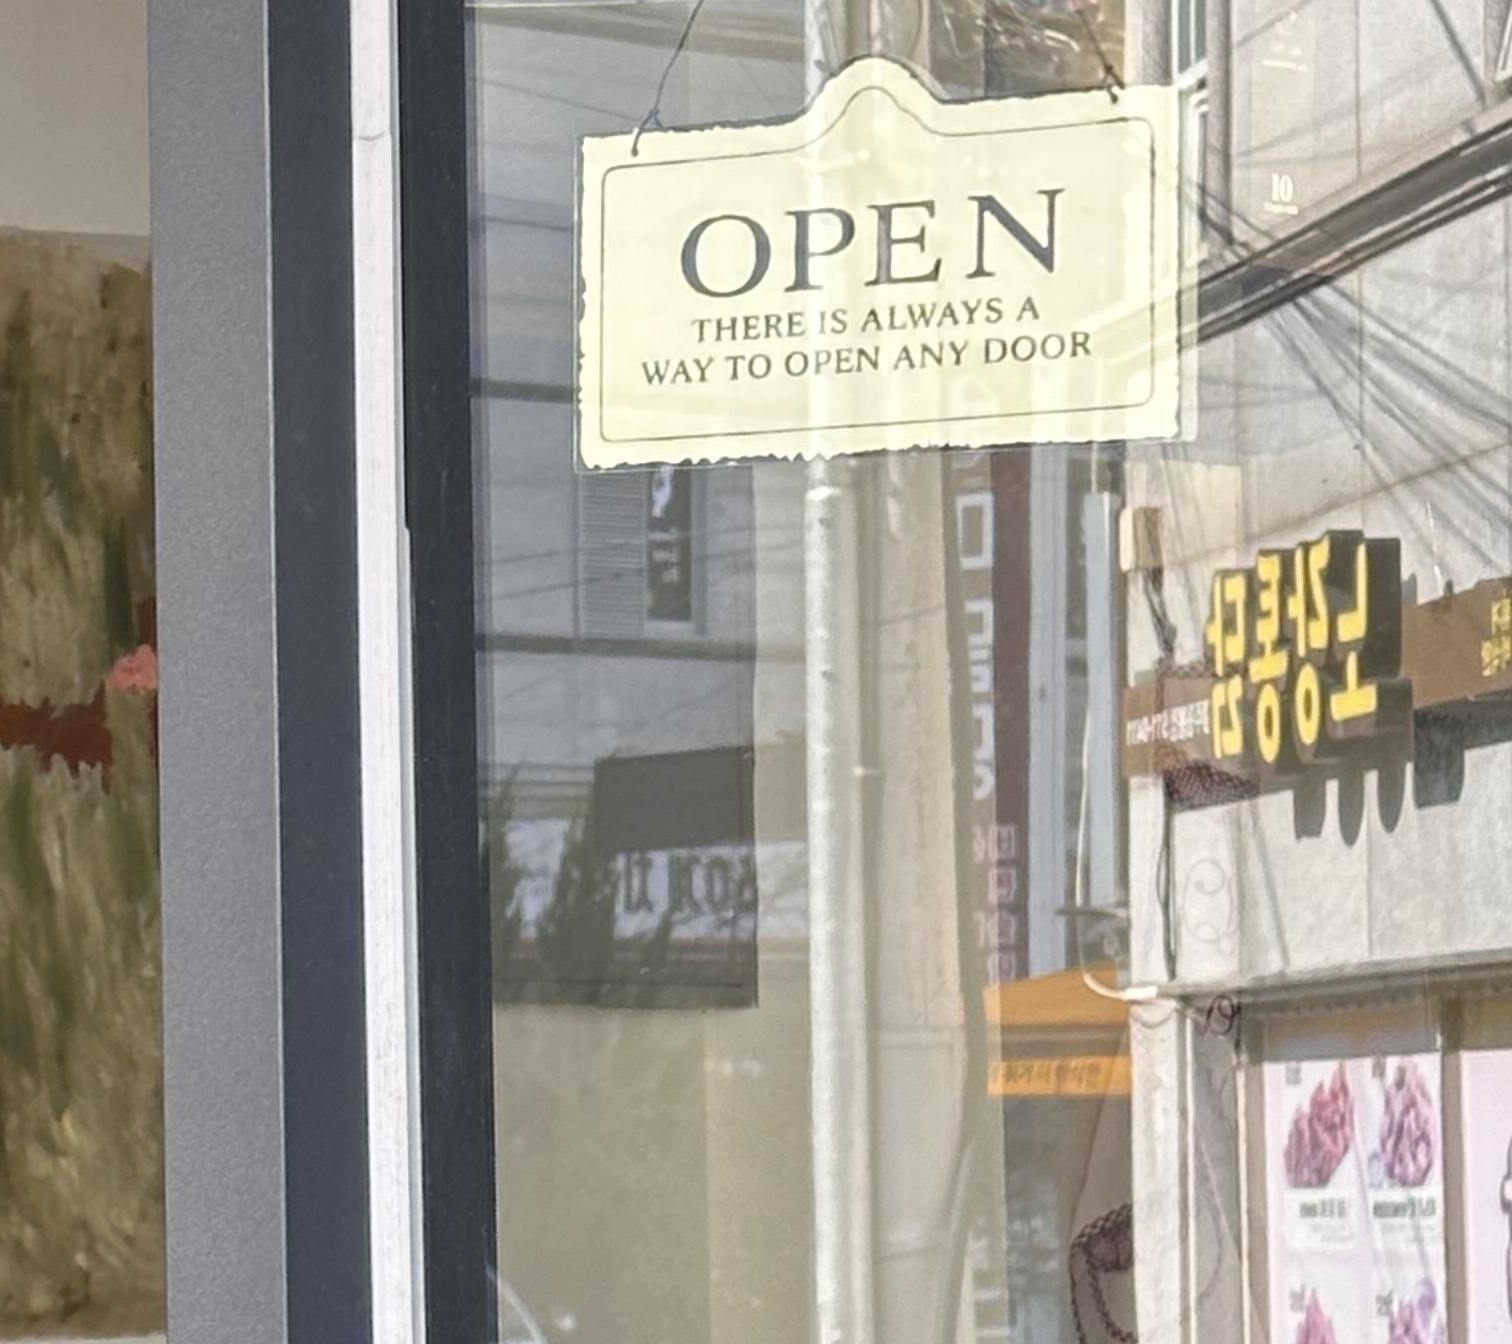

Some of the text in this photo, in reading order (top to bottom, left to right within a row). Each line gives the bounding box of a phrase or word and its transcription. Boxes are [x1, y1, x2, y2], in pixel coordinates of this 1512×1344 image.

[680, 187, 1066, 298] OPEN
[691, 296, 1040, 343] THERE IS ALWAYS A
[641, 331, 1092, 385] WAY TO OPEN ANY DOOR
